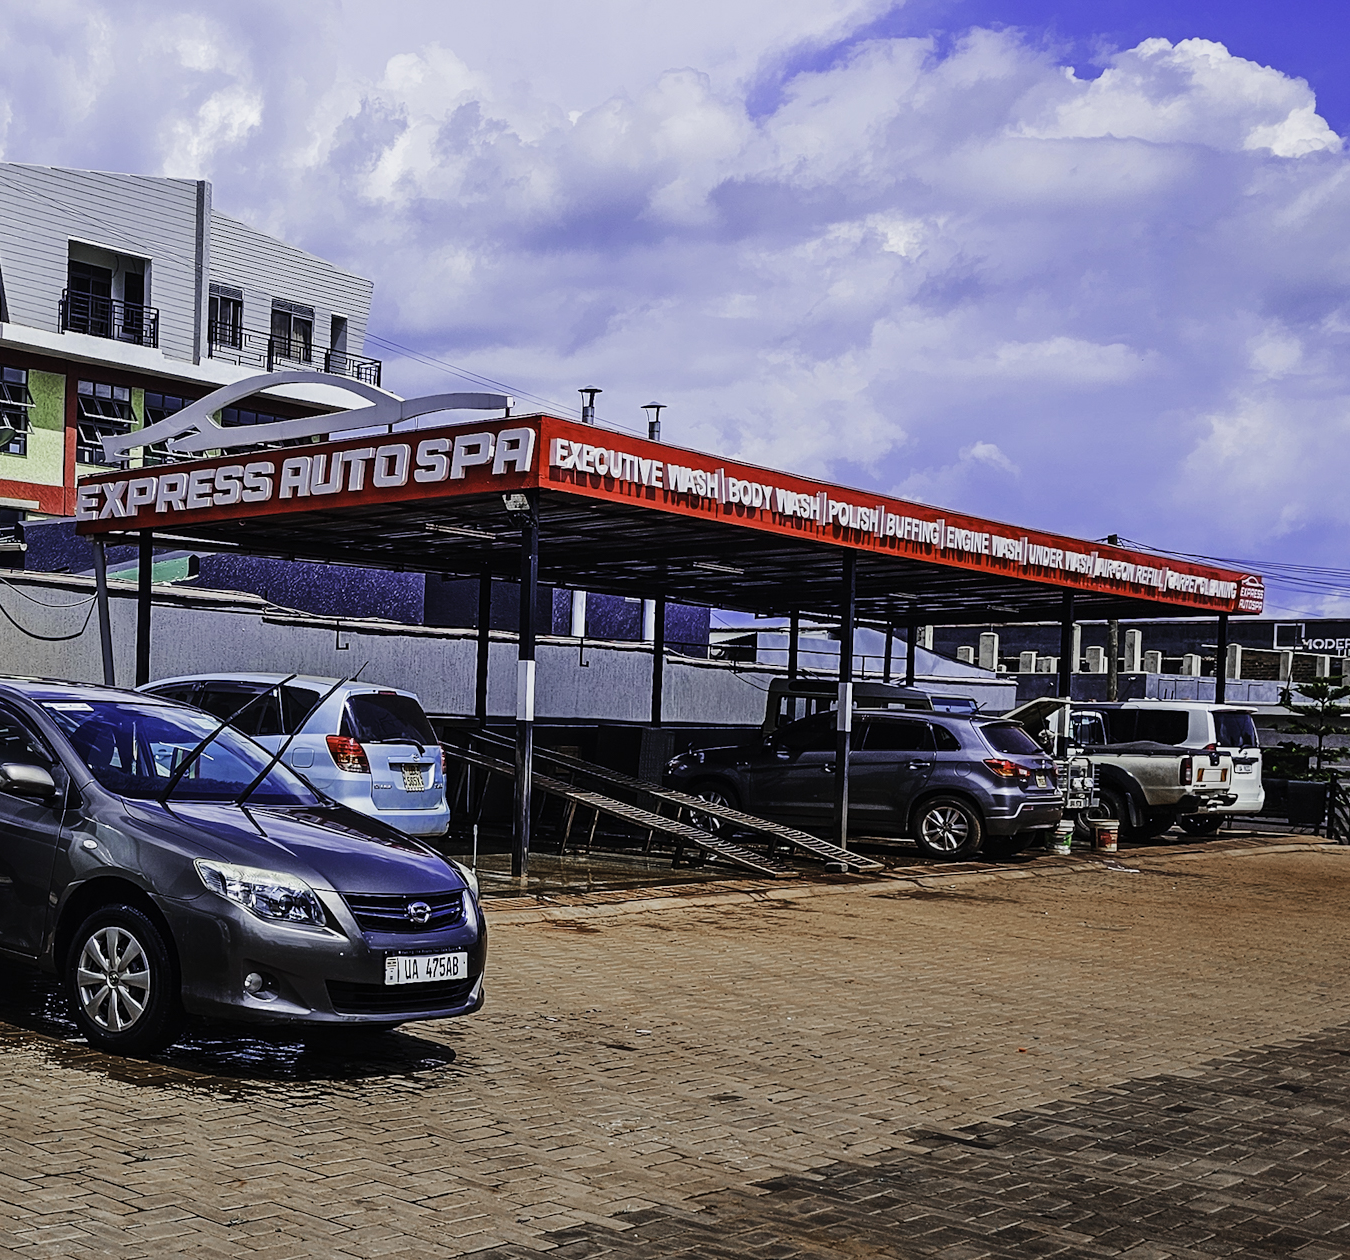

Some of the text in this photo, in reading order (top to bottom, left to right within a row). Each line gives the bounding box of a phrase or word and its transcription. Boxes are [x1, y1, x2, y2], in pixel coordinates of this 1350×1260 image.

[76, 462, 274, 520] EXPRESS
[550, 438, 663, 488] EXECUTIVE
[664, 464, 718, 499] WASH
[725, 477, 773, 510] BODY
[773, 487, 820, 520] WASH
[826, 500, 878, 532] POLISH
[885, 513, 939, 544] BUFFING
[946, 526, 989, 554] ENGINE
[990, 535, 1022, 561] WASH
[1028, 544, 1063, 570] UNDER
[1065, 551, 1092, 576] WASH
[1135, 565, 1163, 587] REFILL
[1167, 571, 1199, 593] CARPET
[1200, 579, 1237, 599] CLEANING
[1240, 587, 1264, 599] EXPRESS
[1238, 599, 1262, 611] AUTOSPA
[404, 956, 459, 979] UA 475AB
